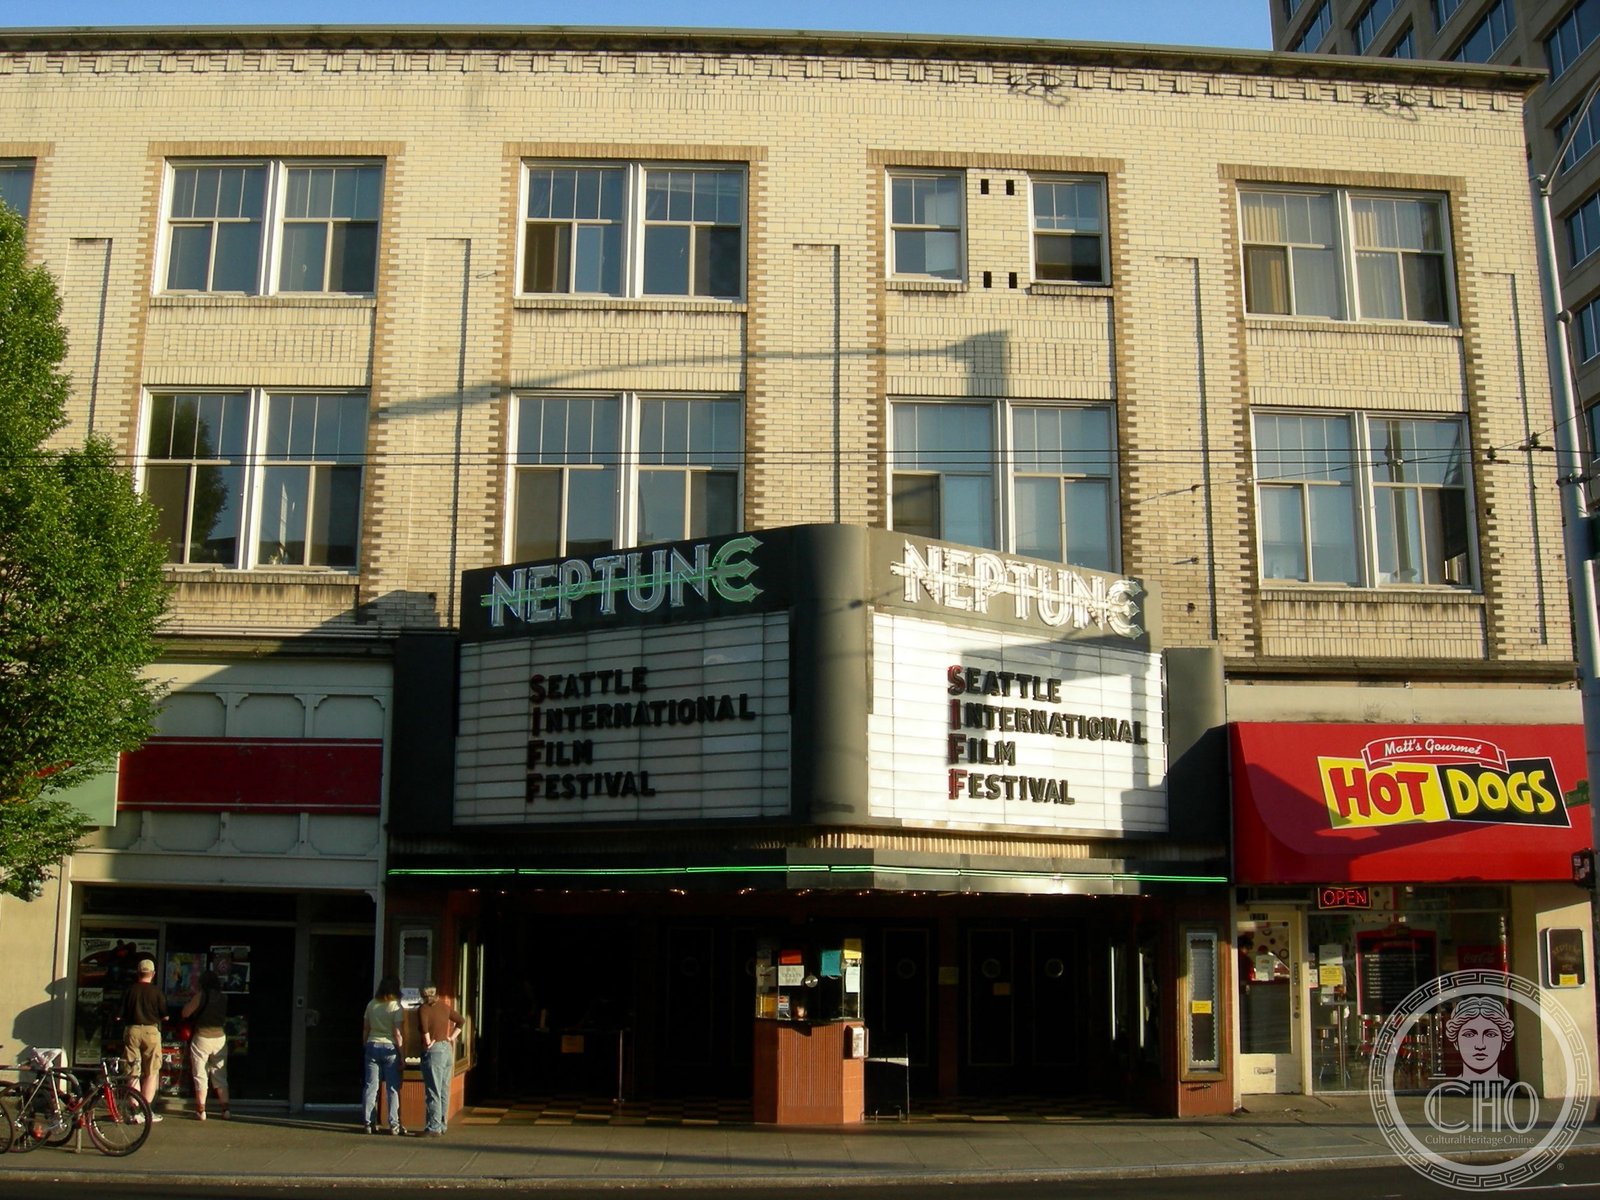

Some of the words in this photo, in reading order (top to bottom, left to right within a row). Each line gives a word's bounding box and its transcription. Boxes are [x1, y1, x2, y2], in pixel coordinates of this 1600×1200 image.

[481, 535, 764, 627] NEPTUNE
[891, 539, 1144, 640] NEPTUNE
[529, 666, 648, 704] SEATTLE
[947, 664, 1062, 703] SEATTLE
[531, 693, 756, 737] INTERNATIONAL
[951, 698, 1148, 745] INTERNATIONAL
[526, 739, 594, 770] FILM
[948, 732, 1017, 766] FILM
[1384, 739, 1422, 757] Matt's
[1424, 738, 1482, 757] Gourmet
[525, 770, 656, 803] FESTIVAL
[948, 768, 1076, 805] FESTIVAL
[1328, 767, 1429, 818] HOT
[1444, 768, 1557, 815] DOGS
[1322, 889, 1368, 906] OPEN
